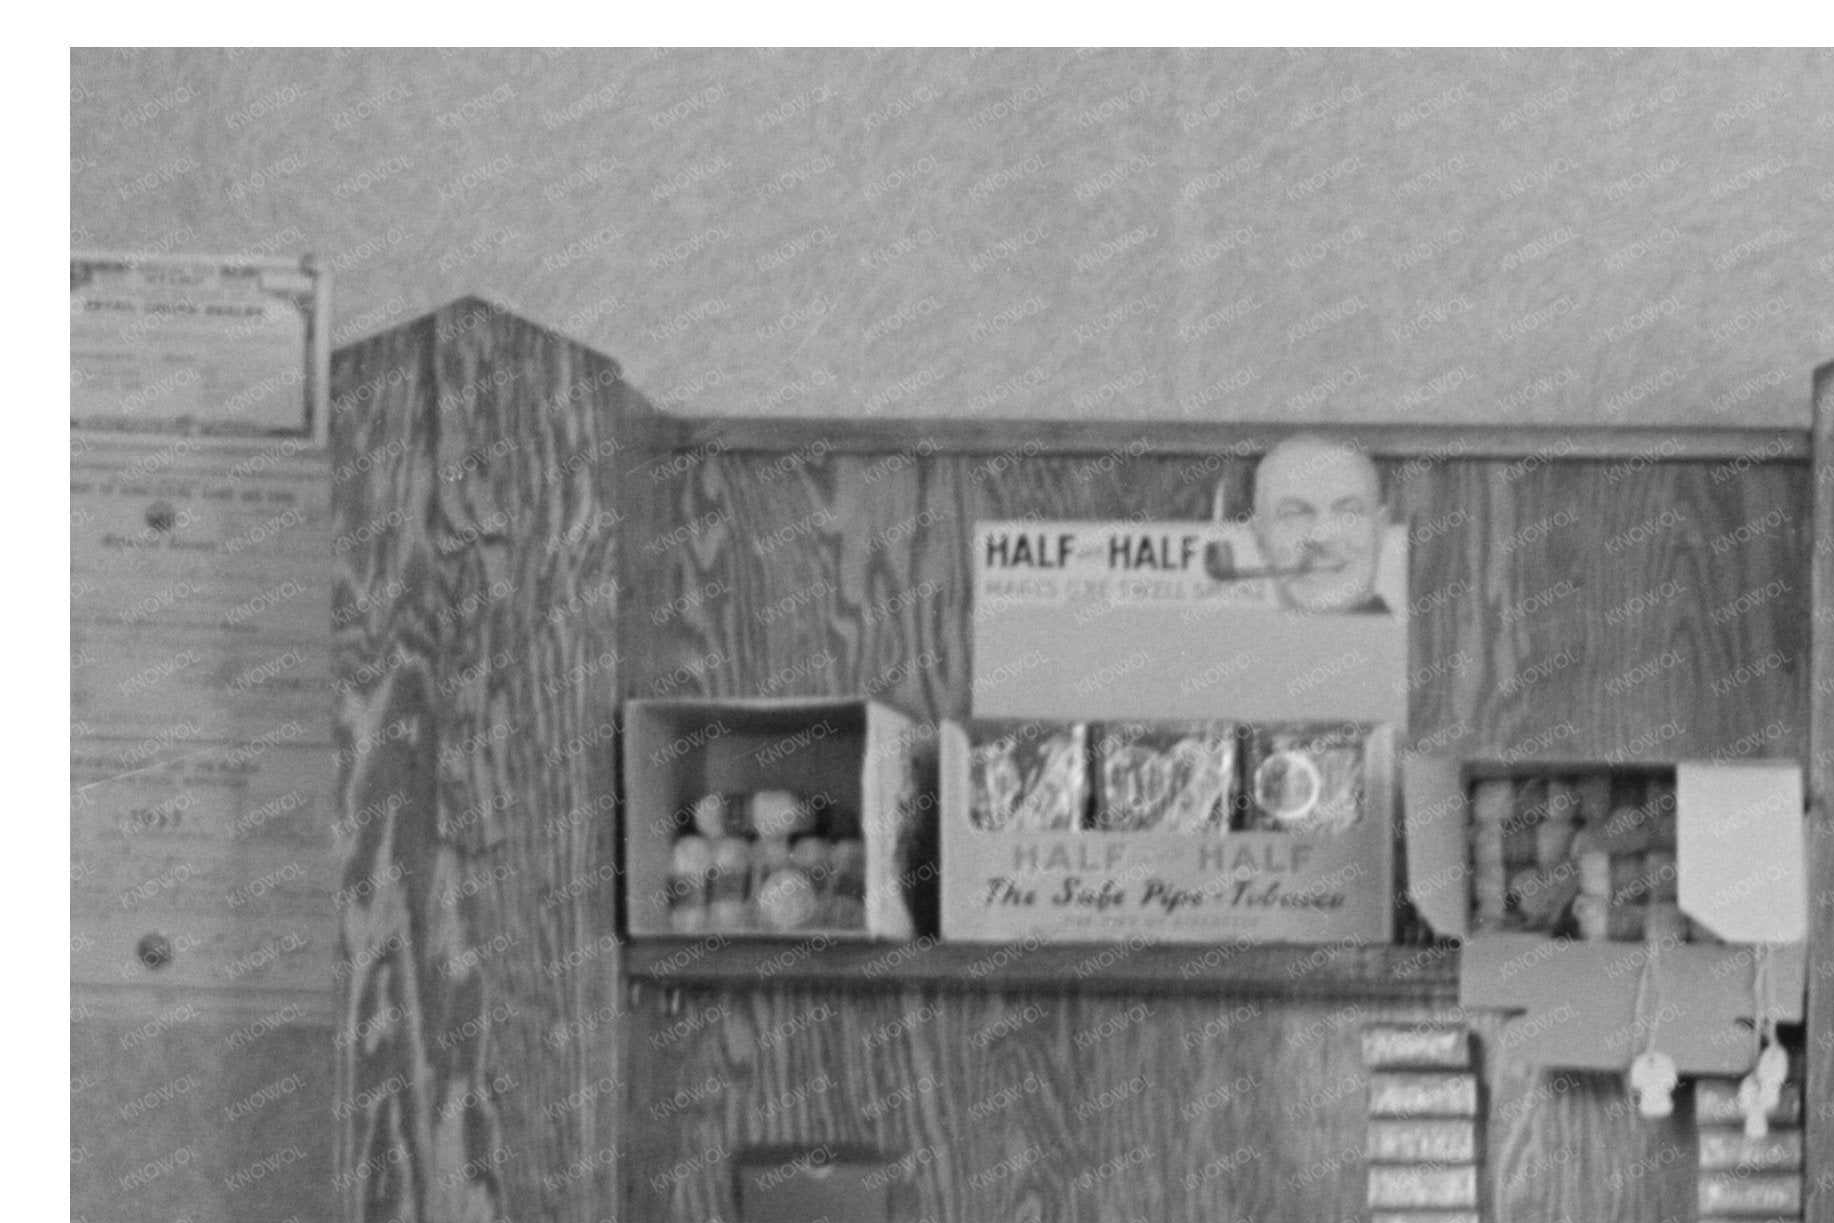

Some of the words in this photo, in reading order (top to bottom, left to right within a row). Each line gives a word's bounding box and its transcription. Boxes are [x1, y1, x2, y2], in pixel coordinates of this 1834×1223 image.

[984, 534, 1076, 569] HALF
[1108, 534, 1201, 569] HALF
[1012, 842, 1127, 872] HALF
[1198, 842, 1316, 873] HALF
[984, 877, 1036, 907] The
[1051, 876, 1127, 912] Safe
